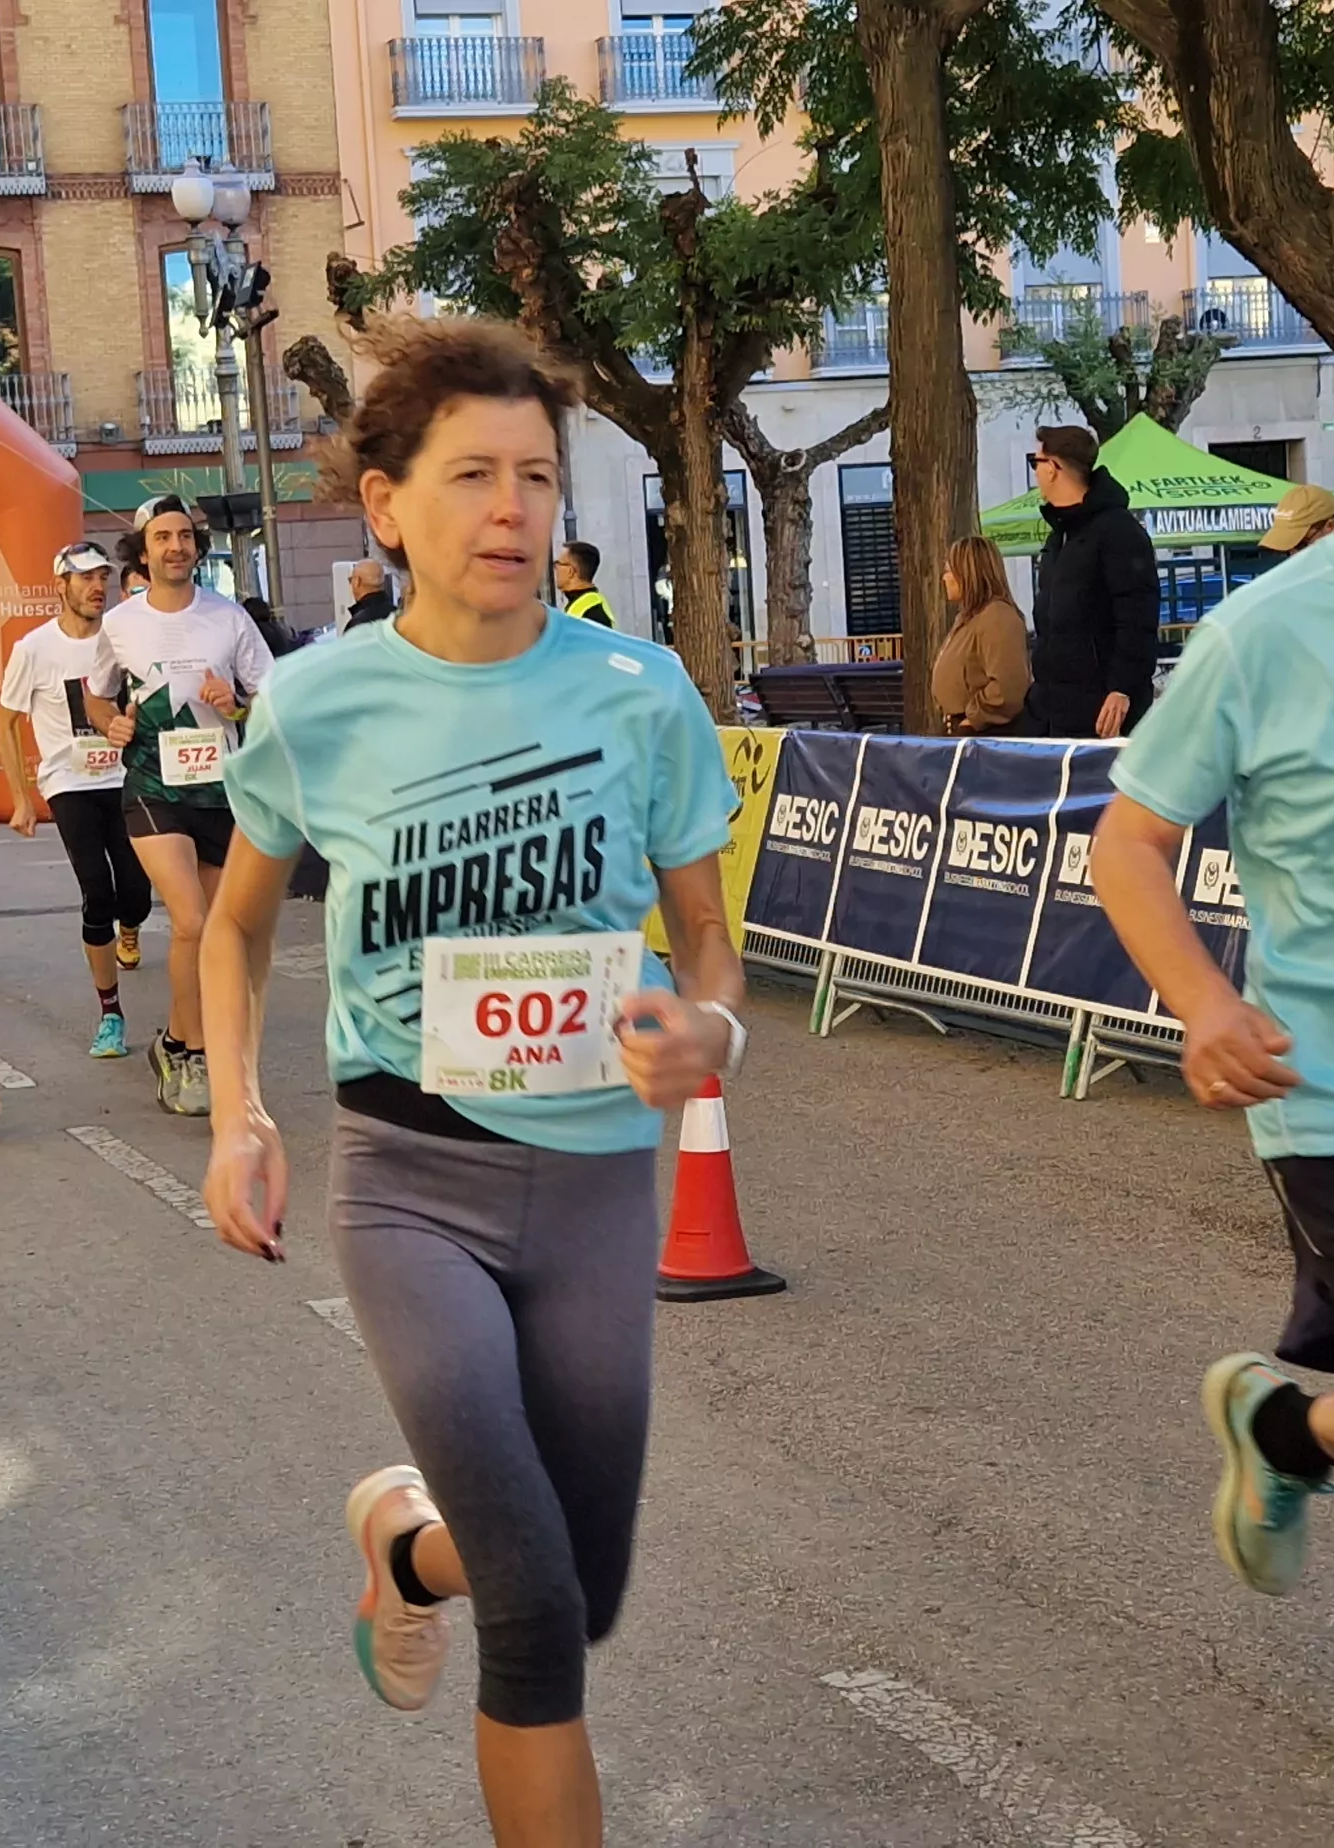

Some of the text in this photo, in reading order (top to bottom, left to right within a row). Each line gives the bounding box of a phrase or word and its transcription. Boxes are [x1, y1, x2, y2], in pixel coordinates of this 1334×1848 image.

[1252, 425, 1262, 440] 2
[1149, 474, 1246, 488] FARTLECK
[1167, 486, 1255, 499] SPORT
[0, 601, 63, 617] Huesca
[87, 750, 119, 765] 520
[177, 745, 218, 764] 572
[186, 763, 212, 773] JUAN
[391, 787, 562, 867] III CARRERA
[786, 795, 840, 845] ESIC
[870, 808, 933, 860] ESIC
[968, 820, 1039, 878] ESIC
[361, 813, 608, 955] EMPRESAS
[474, 987, 589, 1039] 602
[505, 1043, 564, 1066] ANA
[487, 1067, 530, 1092] 8K
